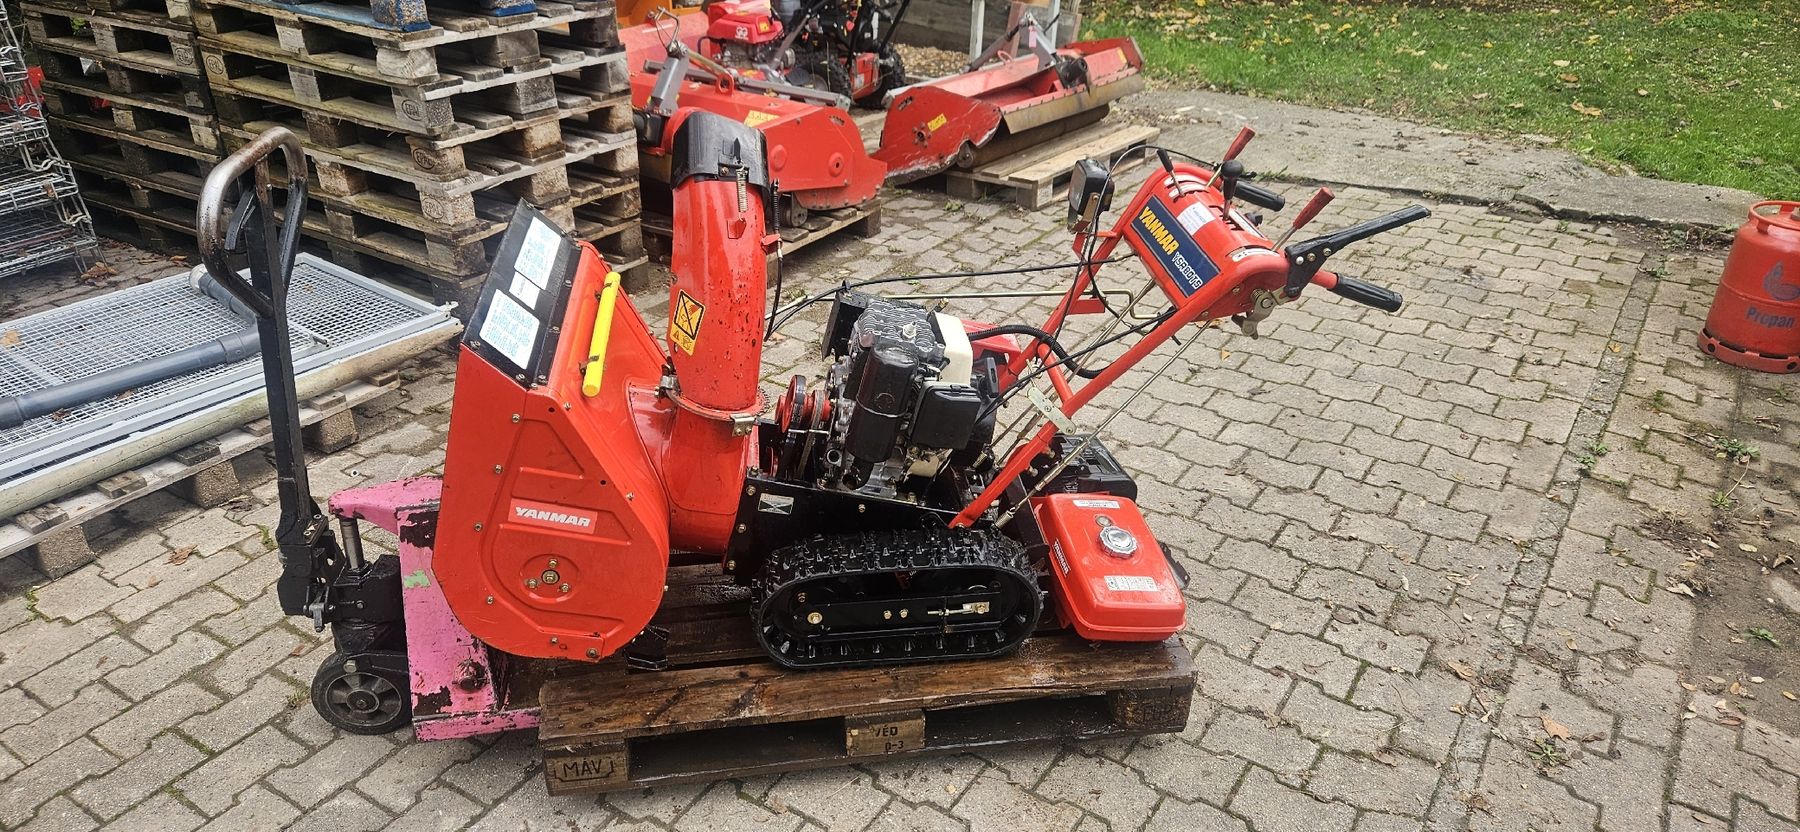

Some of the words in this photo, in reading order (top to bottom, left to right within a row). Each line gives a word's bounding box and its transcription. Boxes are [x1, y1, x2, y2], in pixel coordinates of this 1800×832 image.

[1139, 206, 1180, 256] YANMAR
[1745, 305, 1795, 329] Propan
[514, 506, 592, 527] YANMAR
